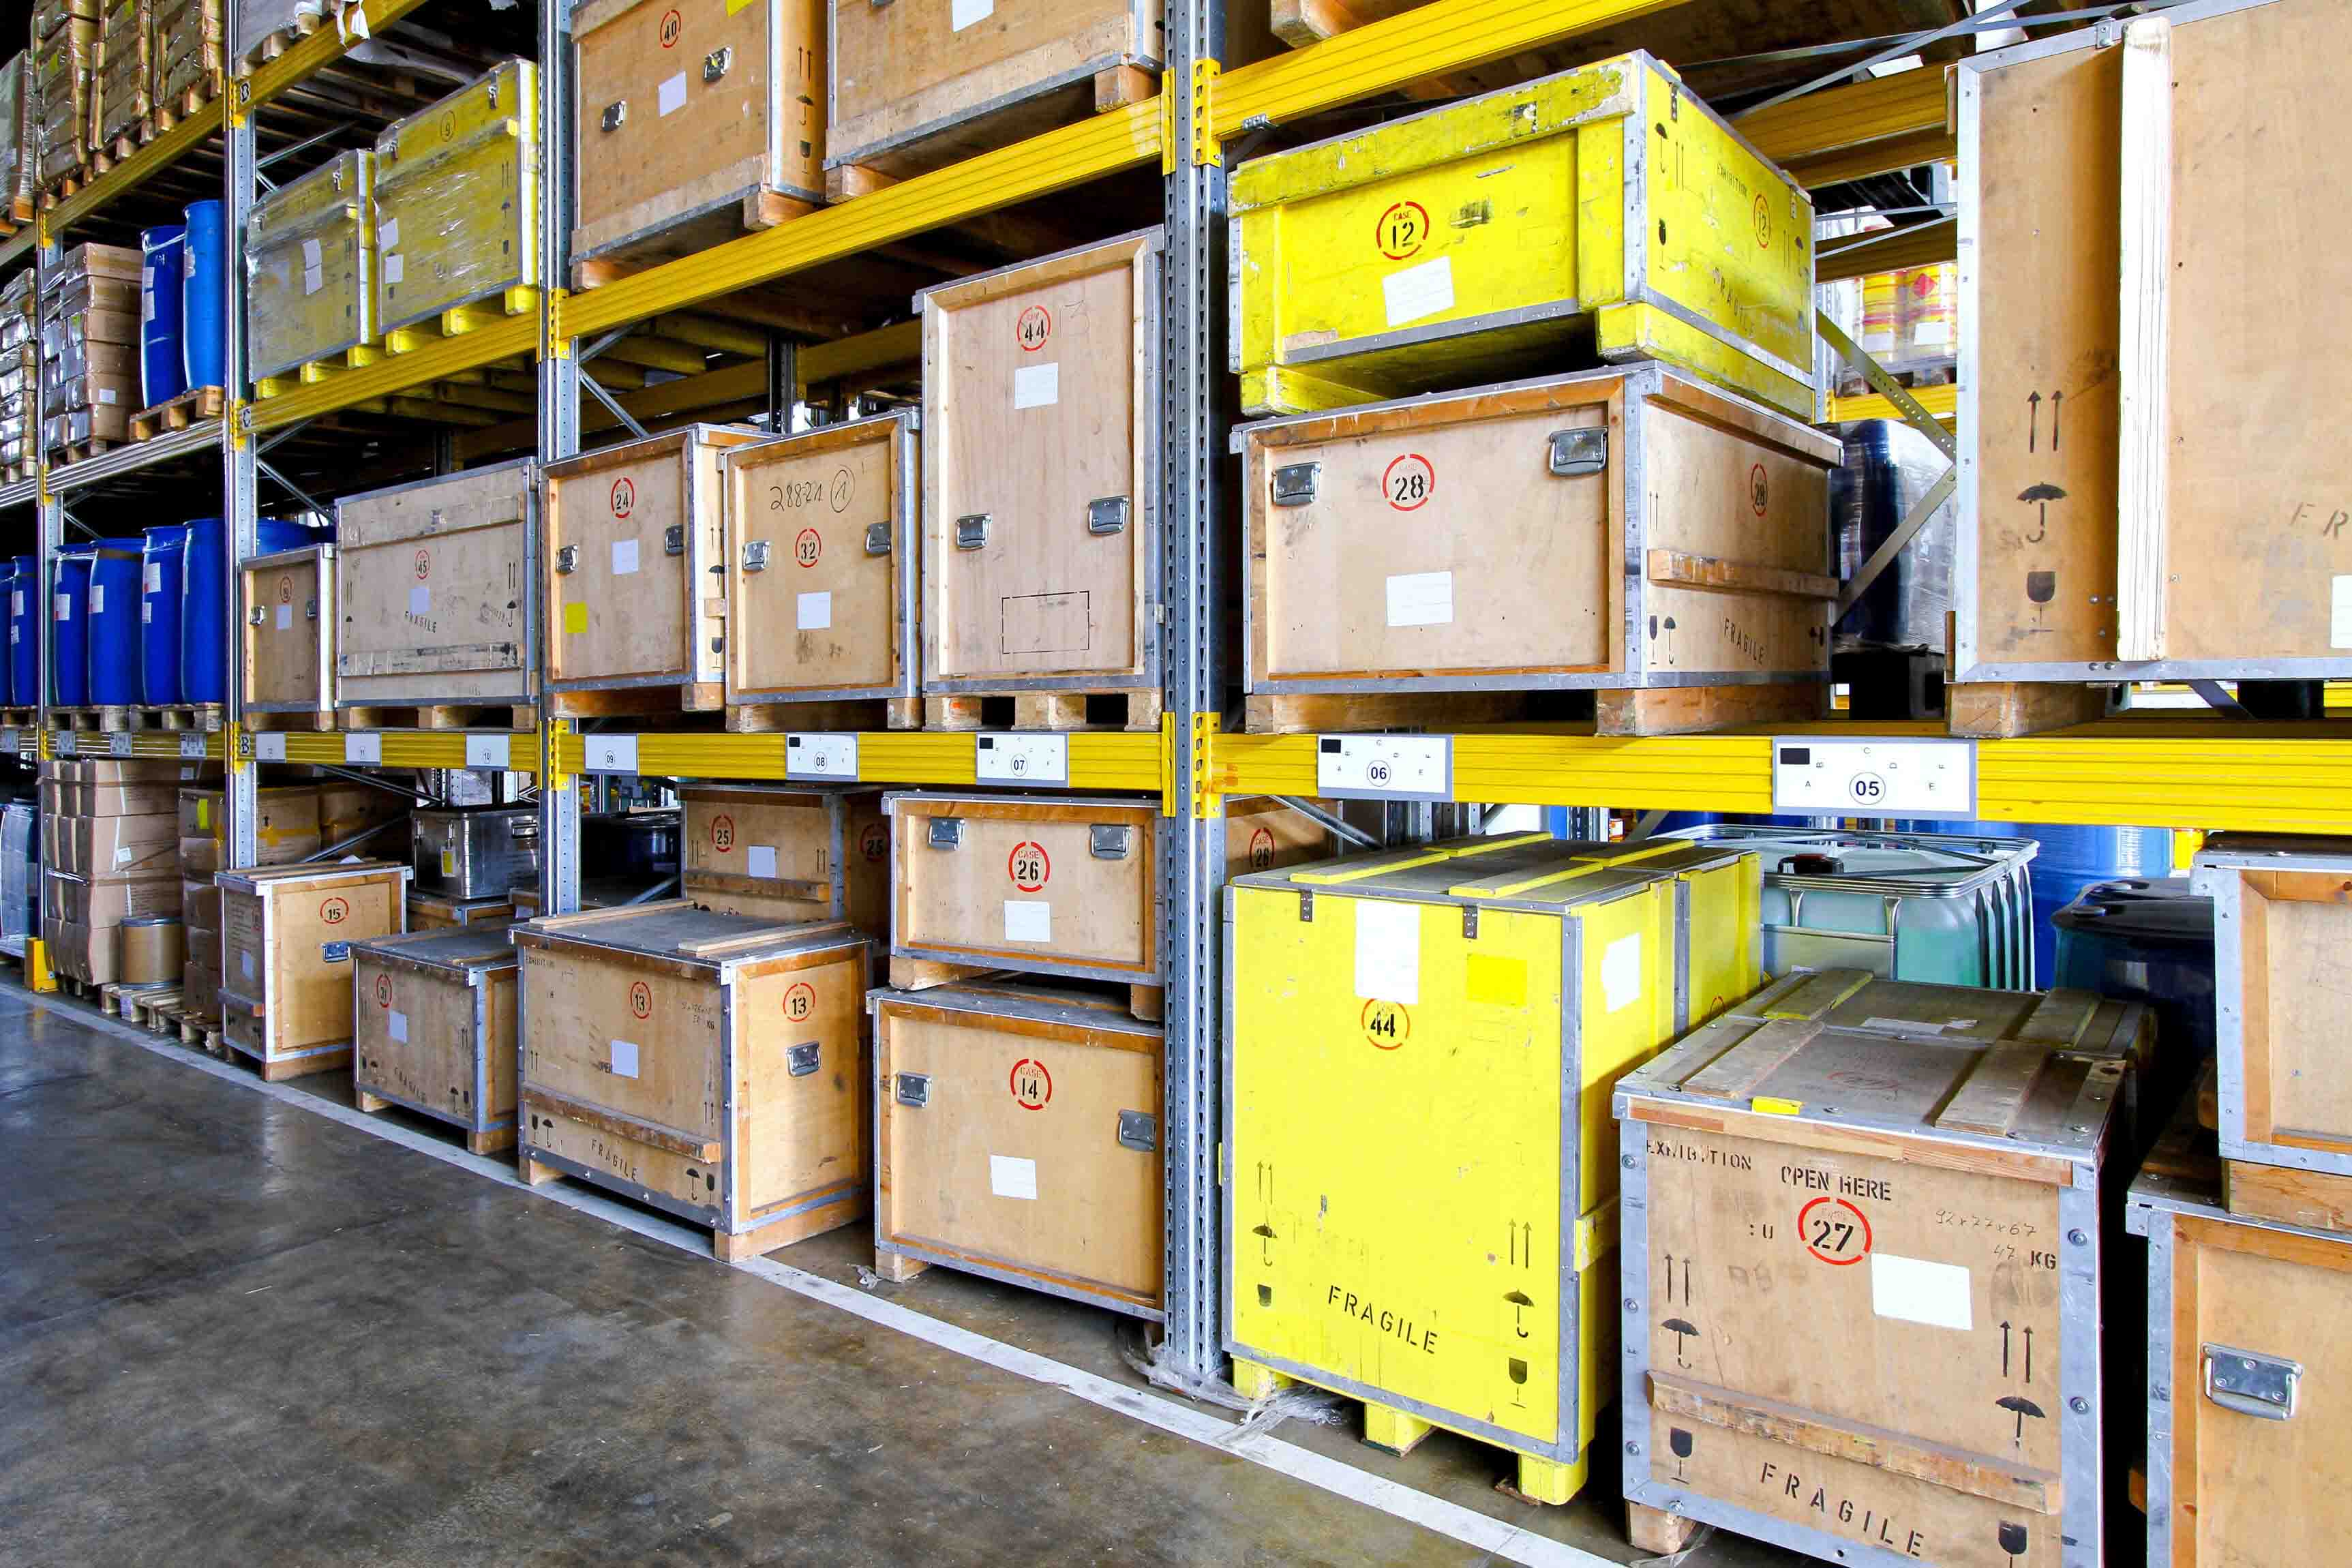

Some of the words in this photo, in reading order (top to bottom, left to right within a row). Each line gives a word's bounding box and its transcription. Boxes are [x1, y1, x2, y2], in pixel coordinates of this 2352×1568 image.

[664, 20, 677, 41] 40
[1717, 163, 1747, 198] EXHIBITION
[1758, 211, 1767, 237] 12
[1392, 222, 1415, 250] 12
[1025, 319, 1045, 342] 44
[1394, 474, 1424, 501] 28
[1755, 482, 1767, 507] 28
[616, 492, 629, 511] 24
[800, 542, 816, 560] 32
[418, 560, 427, 573] 45
[1723, 617, 1764, 665] FRAGILE
[241, 736, 250, 754] B
[483, 751, 490, 761] 10
[606, 755, 614, 764] 09
[816, 757, 825, 767] 08
[1014, 759, 1025, 771] 07
[1370, 766, 1387, 780] 06
[1855, 781, 1880, 796] 05
[717, 828, 729, 845] 25
[1018, 849, 1040, 859] CASE
[1018, 859, 1039, 881] 26
[328, 908, 341, 920] 15
[635, 994, 645, 1012] 13
[791, 996, 806, 1015] 13
[706, 1020, 715, 1031] KG
[1370, 1011, 1396, 1037] 44
[1022, 1077, 1038, 1100] 14
[591, 1139, 638, 1181] FRAGILE
[1781, 1165, 1830, 1191] OPEN
[1839, 1175, 1892, 1201] HERE
[1813, 1219, 1854, 1252] 27
[2030, 1250, 2056, 1270] KG
[1328, 1284, 1438, 1355] FRAGILE
[1761, 1462, 1925, 1557] FRAGILE
